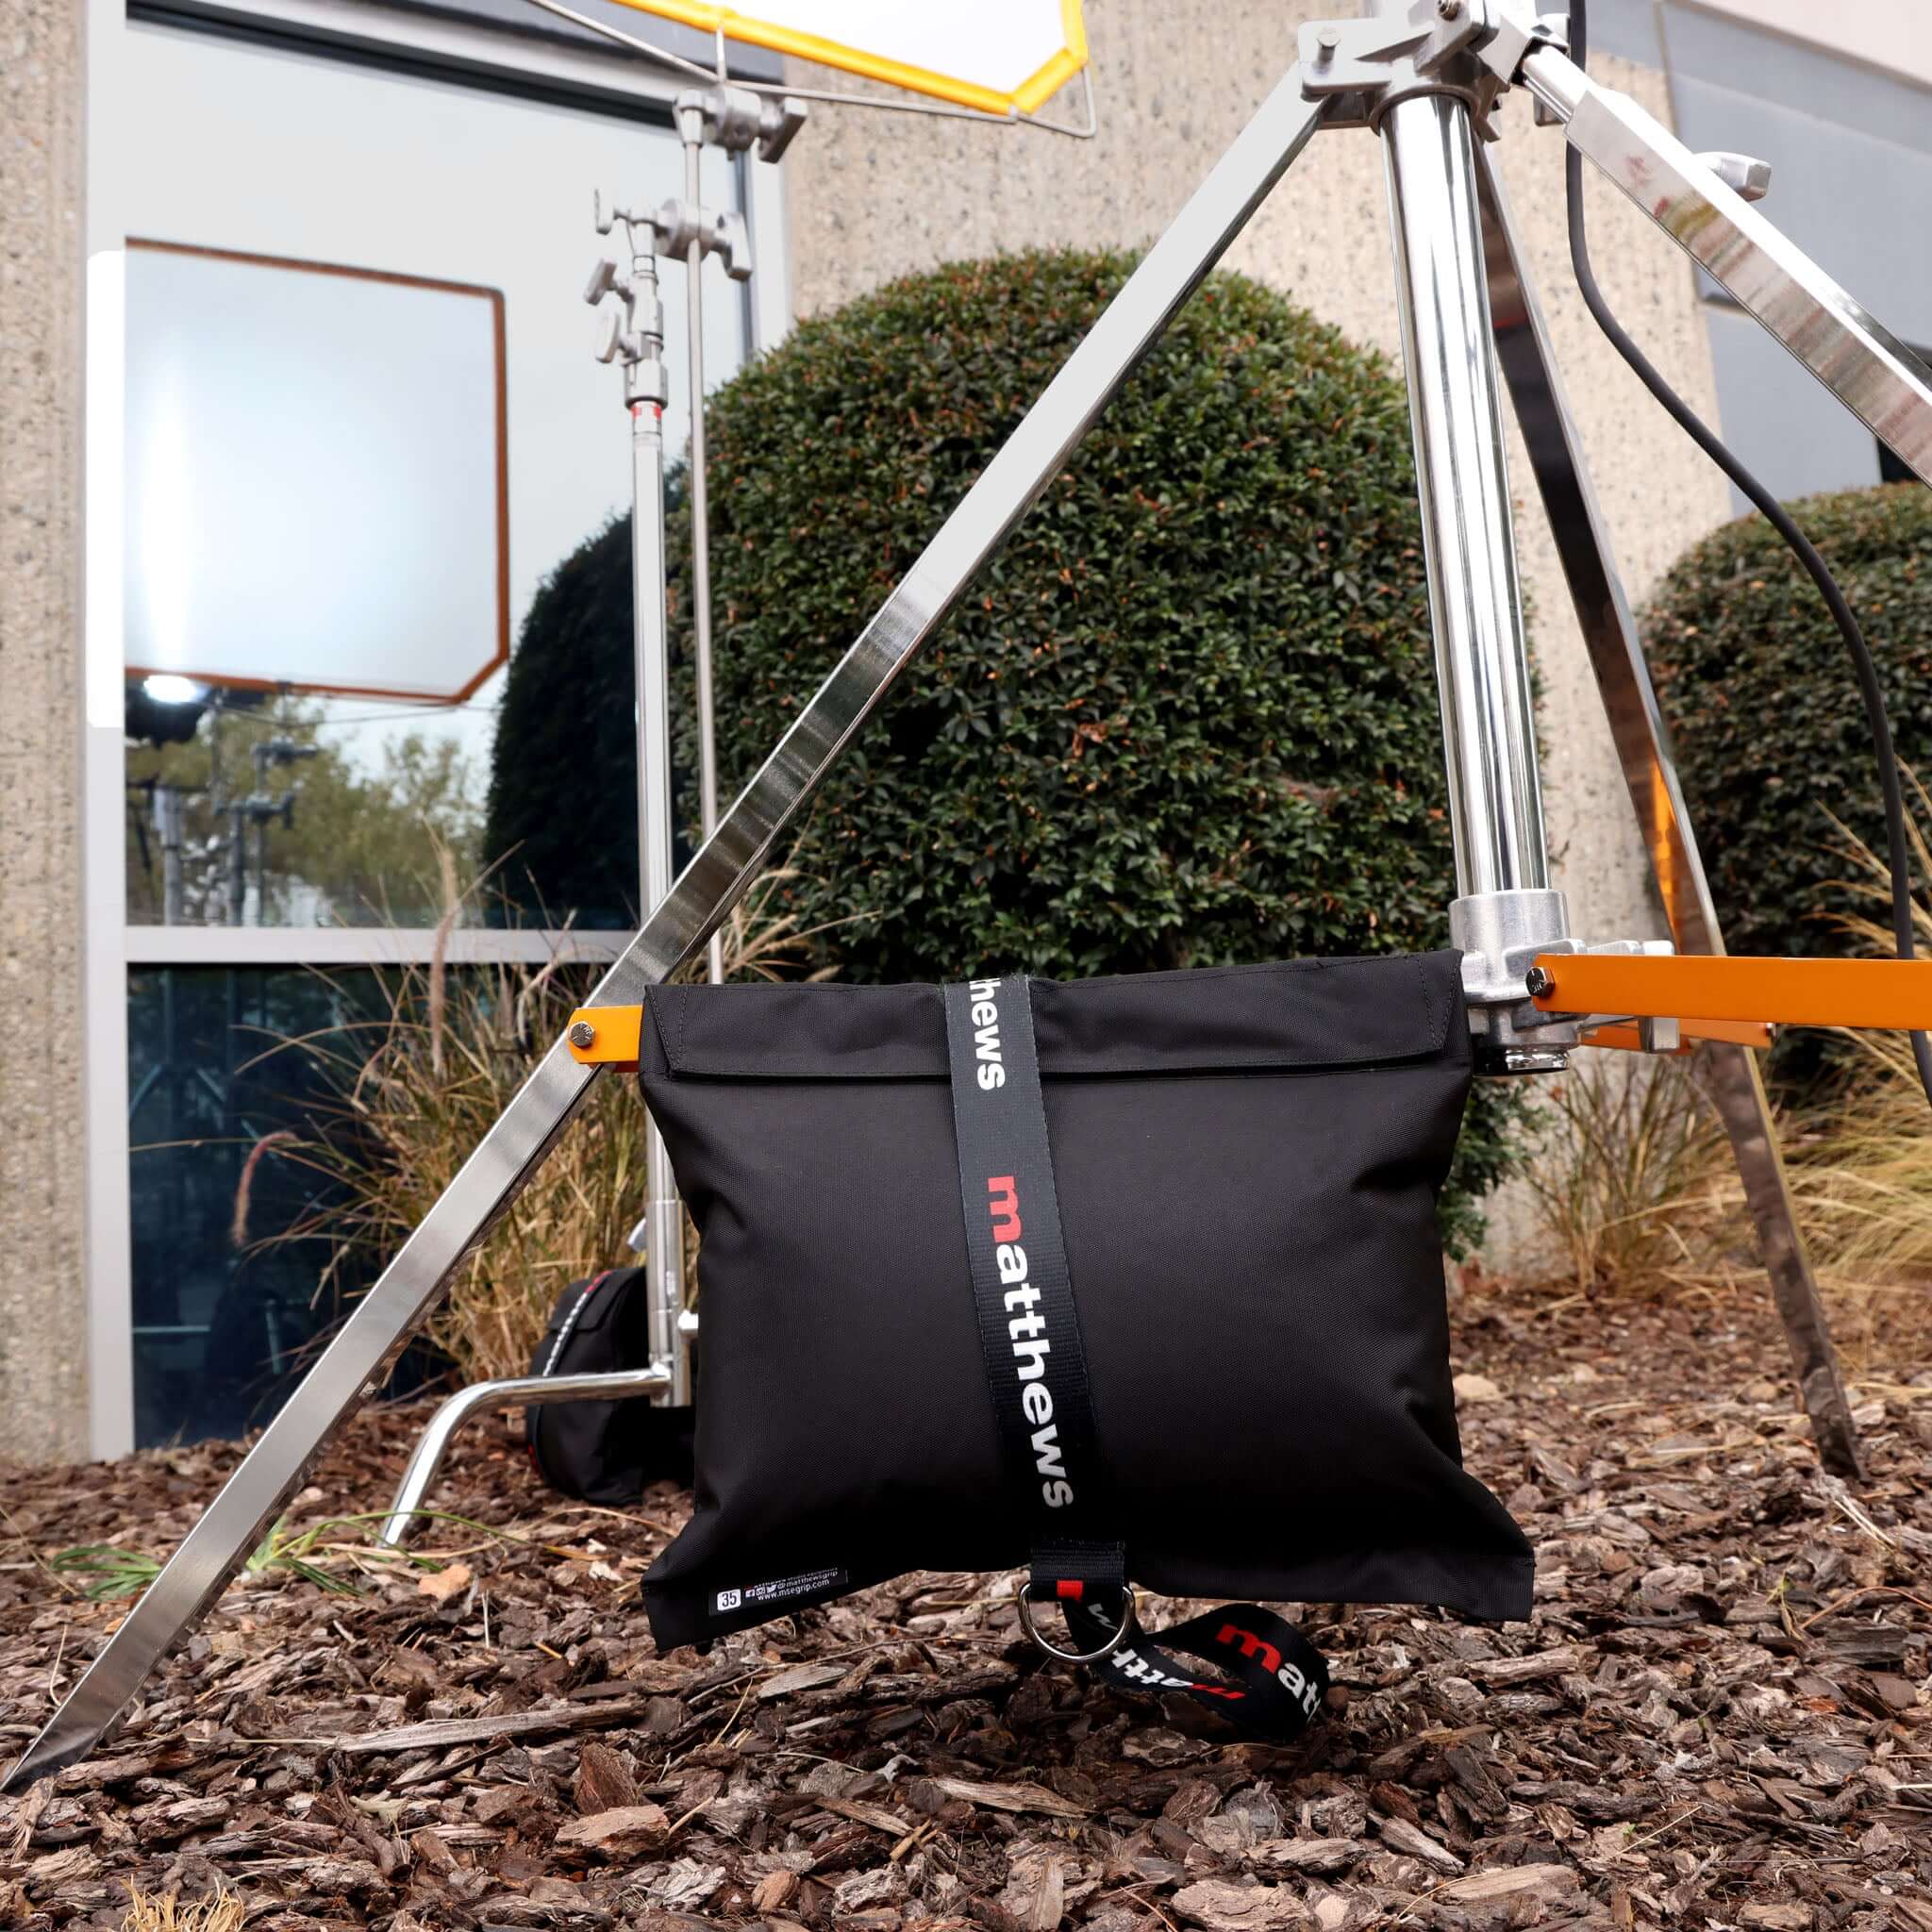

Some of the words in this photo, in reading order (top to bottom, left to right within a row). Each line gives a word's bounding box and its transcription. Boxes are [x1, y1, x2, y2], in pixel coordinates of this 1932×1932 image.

[969, 978, 1006, 1091] hews
[988, 1175, 1074, 1508] matthews
[721, 1591, 738, 1607] 35
[757, 1577, 830, 1601] www.msegrip.com
[1215, 1624, 1321, 1722] mat
